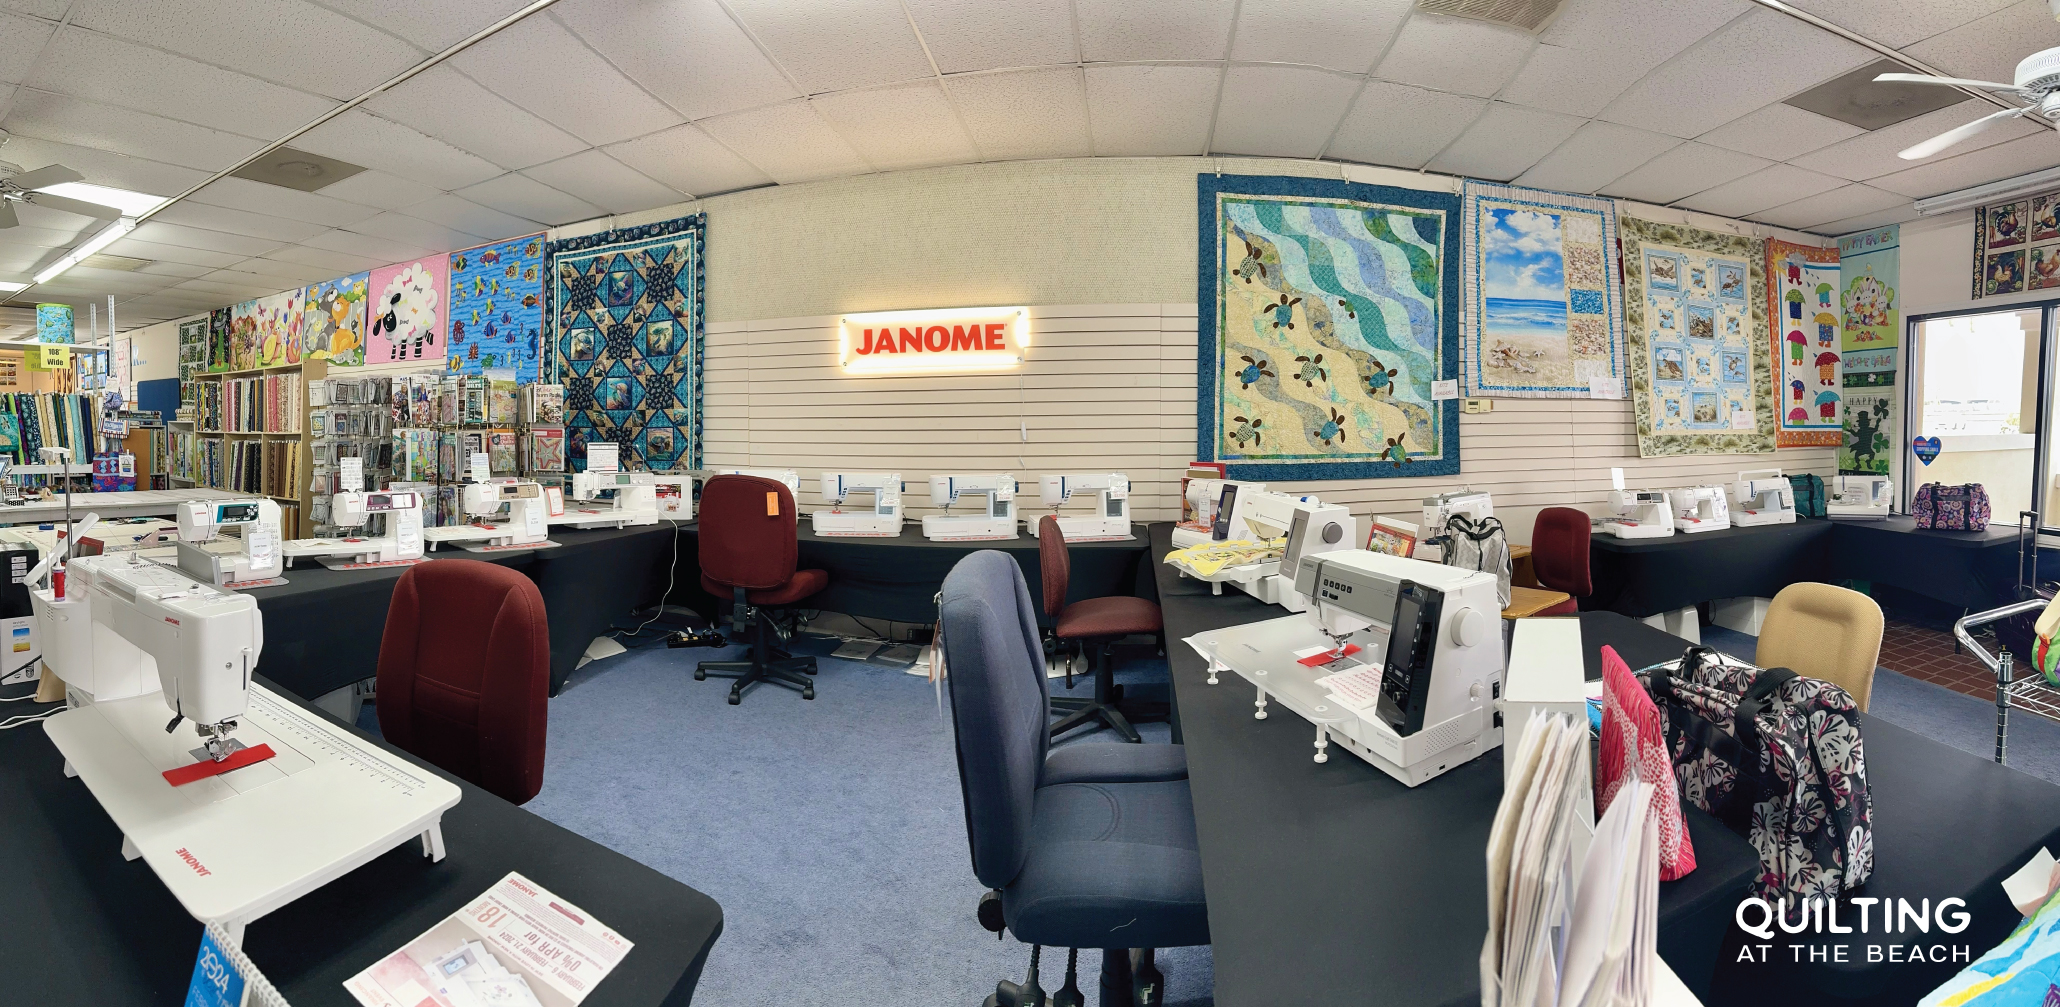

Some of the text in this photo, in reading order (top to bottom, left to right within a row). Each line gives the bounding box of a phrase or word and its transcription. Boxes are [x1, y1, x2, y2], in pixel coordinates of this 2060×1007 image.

[855, 323, 1006, 356] JANOME
[47, 359, 64, 367] Wide
[1849, 397, 1878, 406] HAPPY
[165, 616, 180, 626] JANOME
[175, 847, 211, 877] JANOME
[507, 878, 538, 897] JANOME
[477, 906, 508, 928] 18
[499, 931, 515, 943] 2024
[522, 946, 548, 967] FEBRUARY
[524, 931, 582, 972] 0% APR for
[201, 946, 229, 994] 2024
[555, 969, 586, 991] FEBRUARY
